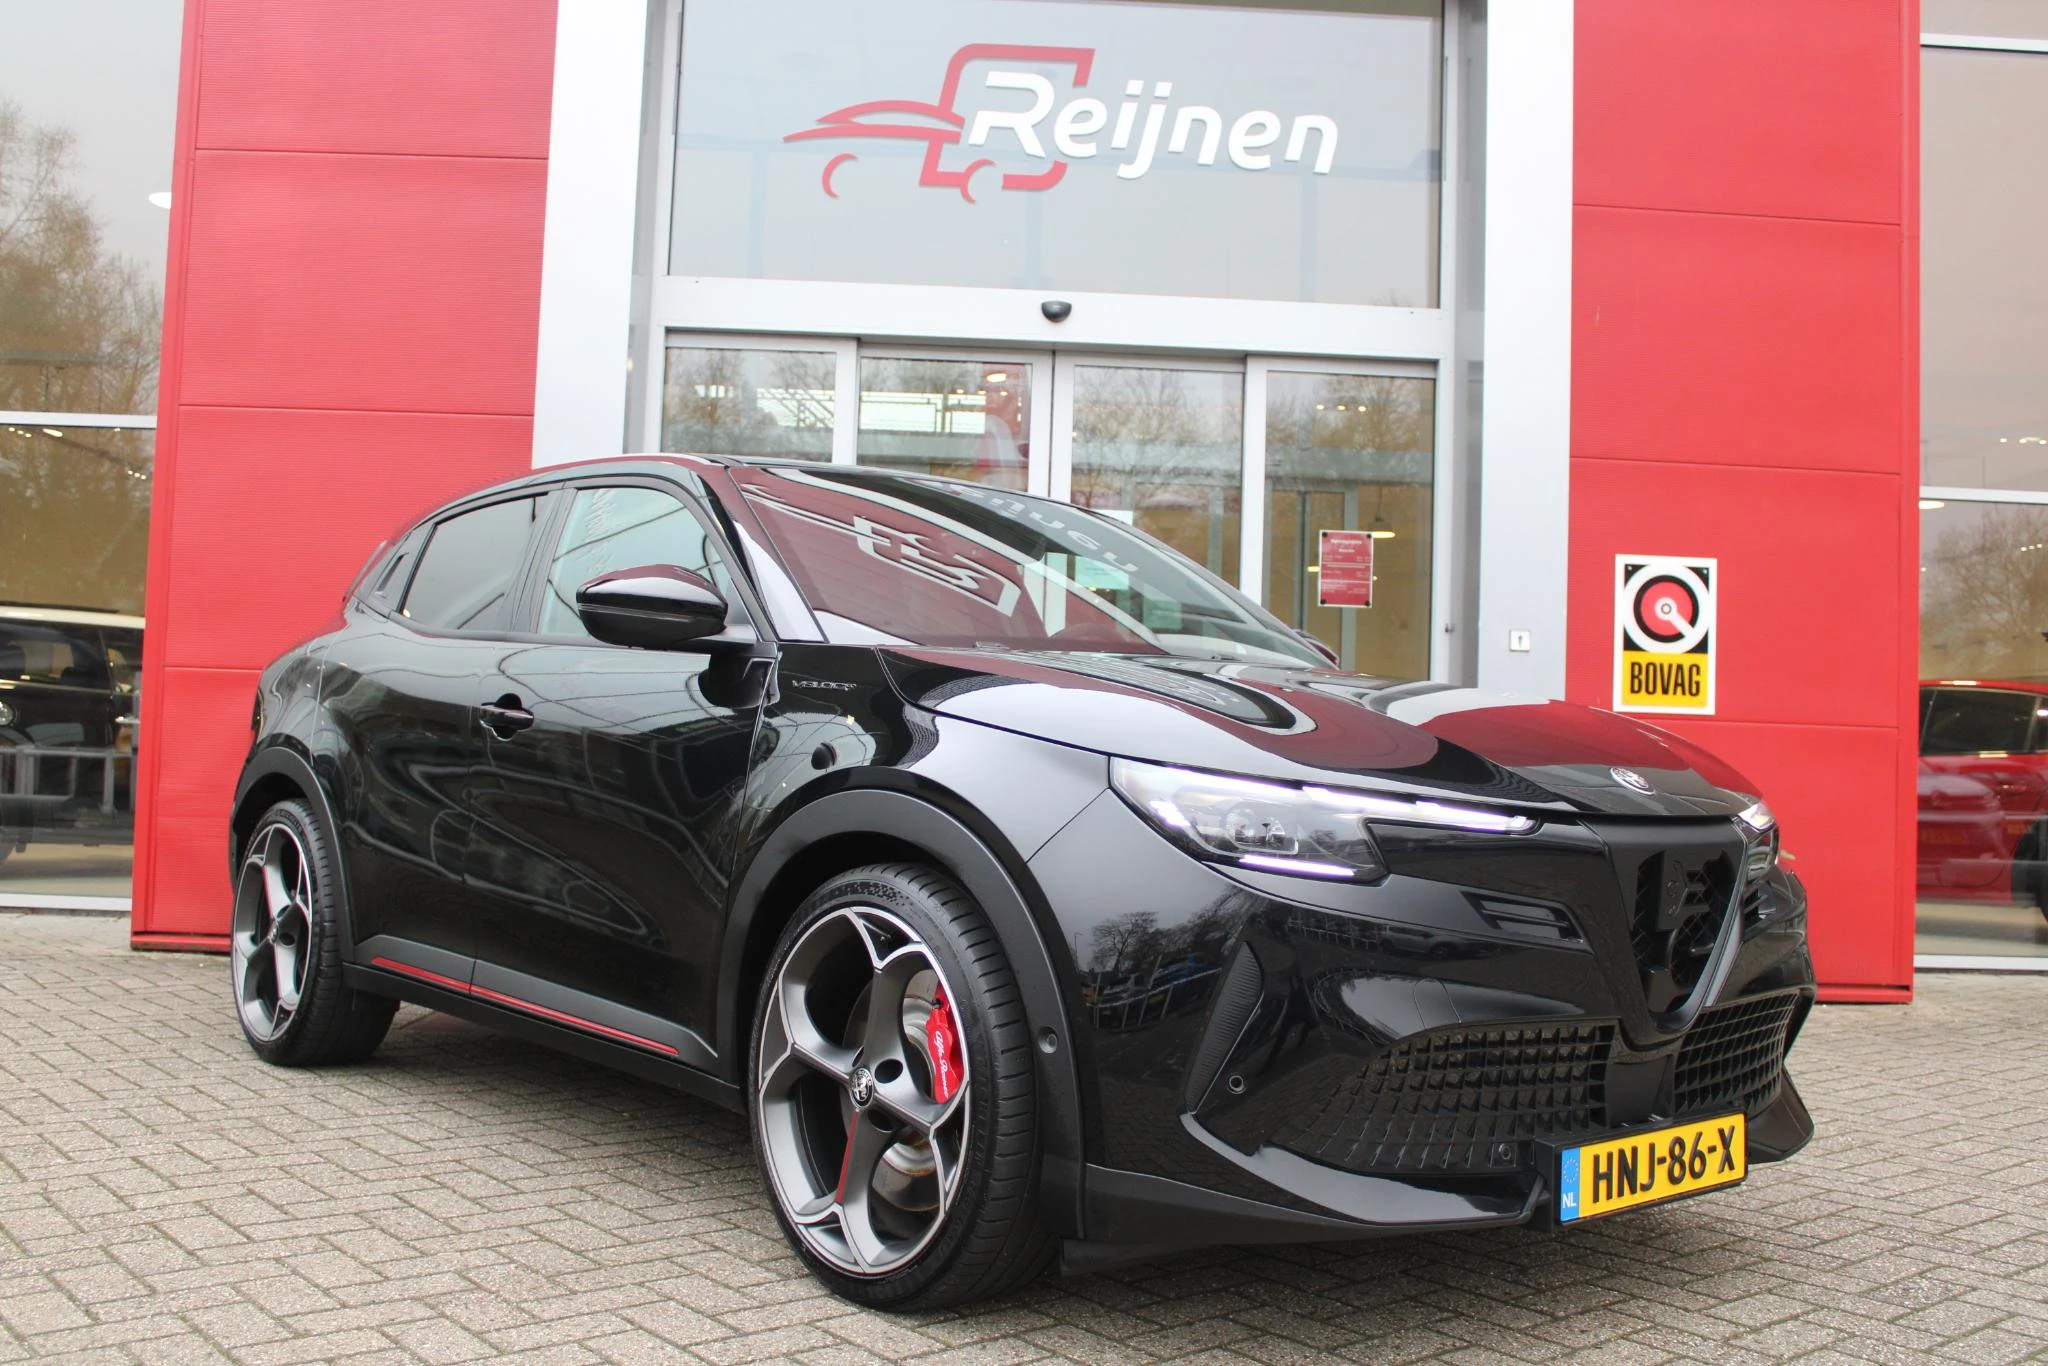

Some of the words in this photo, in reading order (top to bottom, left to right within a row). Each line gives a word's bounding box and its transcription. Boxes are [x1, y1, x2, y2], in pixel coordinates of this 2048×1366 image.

[968, 72, 1339, 179] Reijnen
[1630, 662, 1700, 696] BOVAG
[1592, 1125, 1735, 1203] HNJ-86-X
[1563, 1192, 1577, 1208] NL
